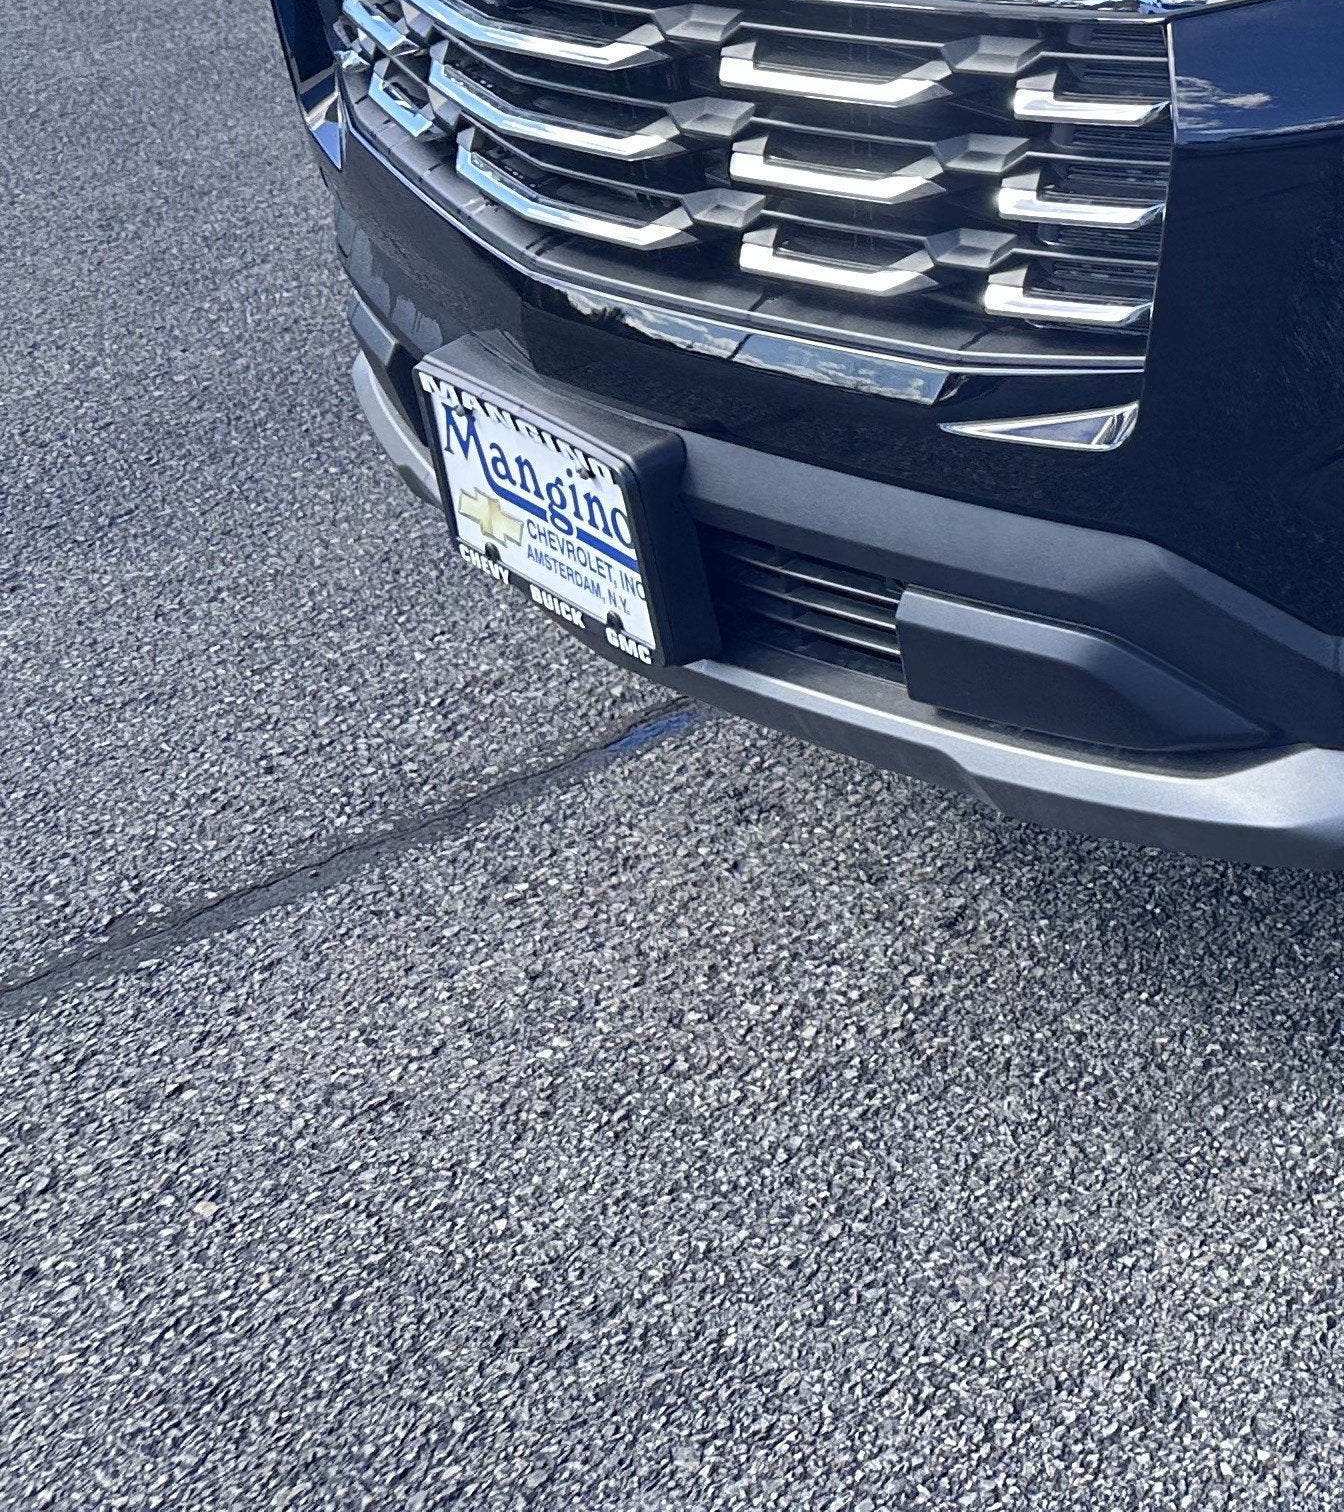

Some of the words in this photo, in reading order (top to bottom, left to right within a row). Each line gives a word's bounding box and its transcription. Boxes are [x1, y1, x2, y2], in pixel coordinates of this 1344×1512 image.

[418, 371, 619, 486] MANGINO
[442, 402, 636, 549] Mangino
[459, 543, 511, 585] CHEVY
[530, 584, 587, 629] BUICK
[605, 626, 652, 665] GMC
[527, 518, 618, 589] CHEVROLET,
